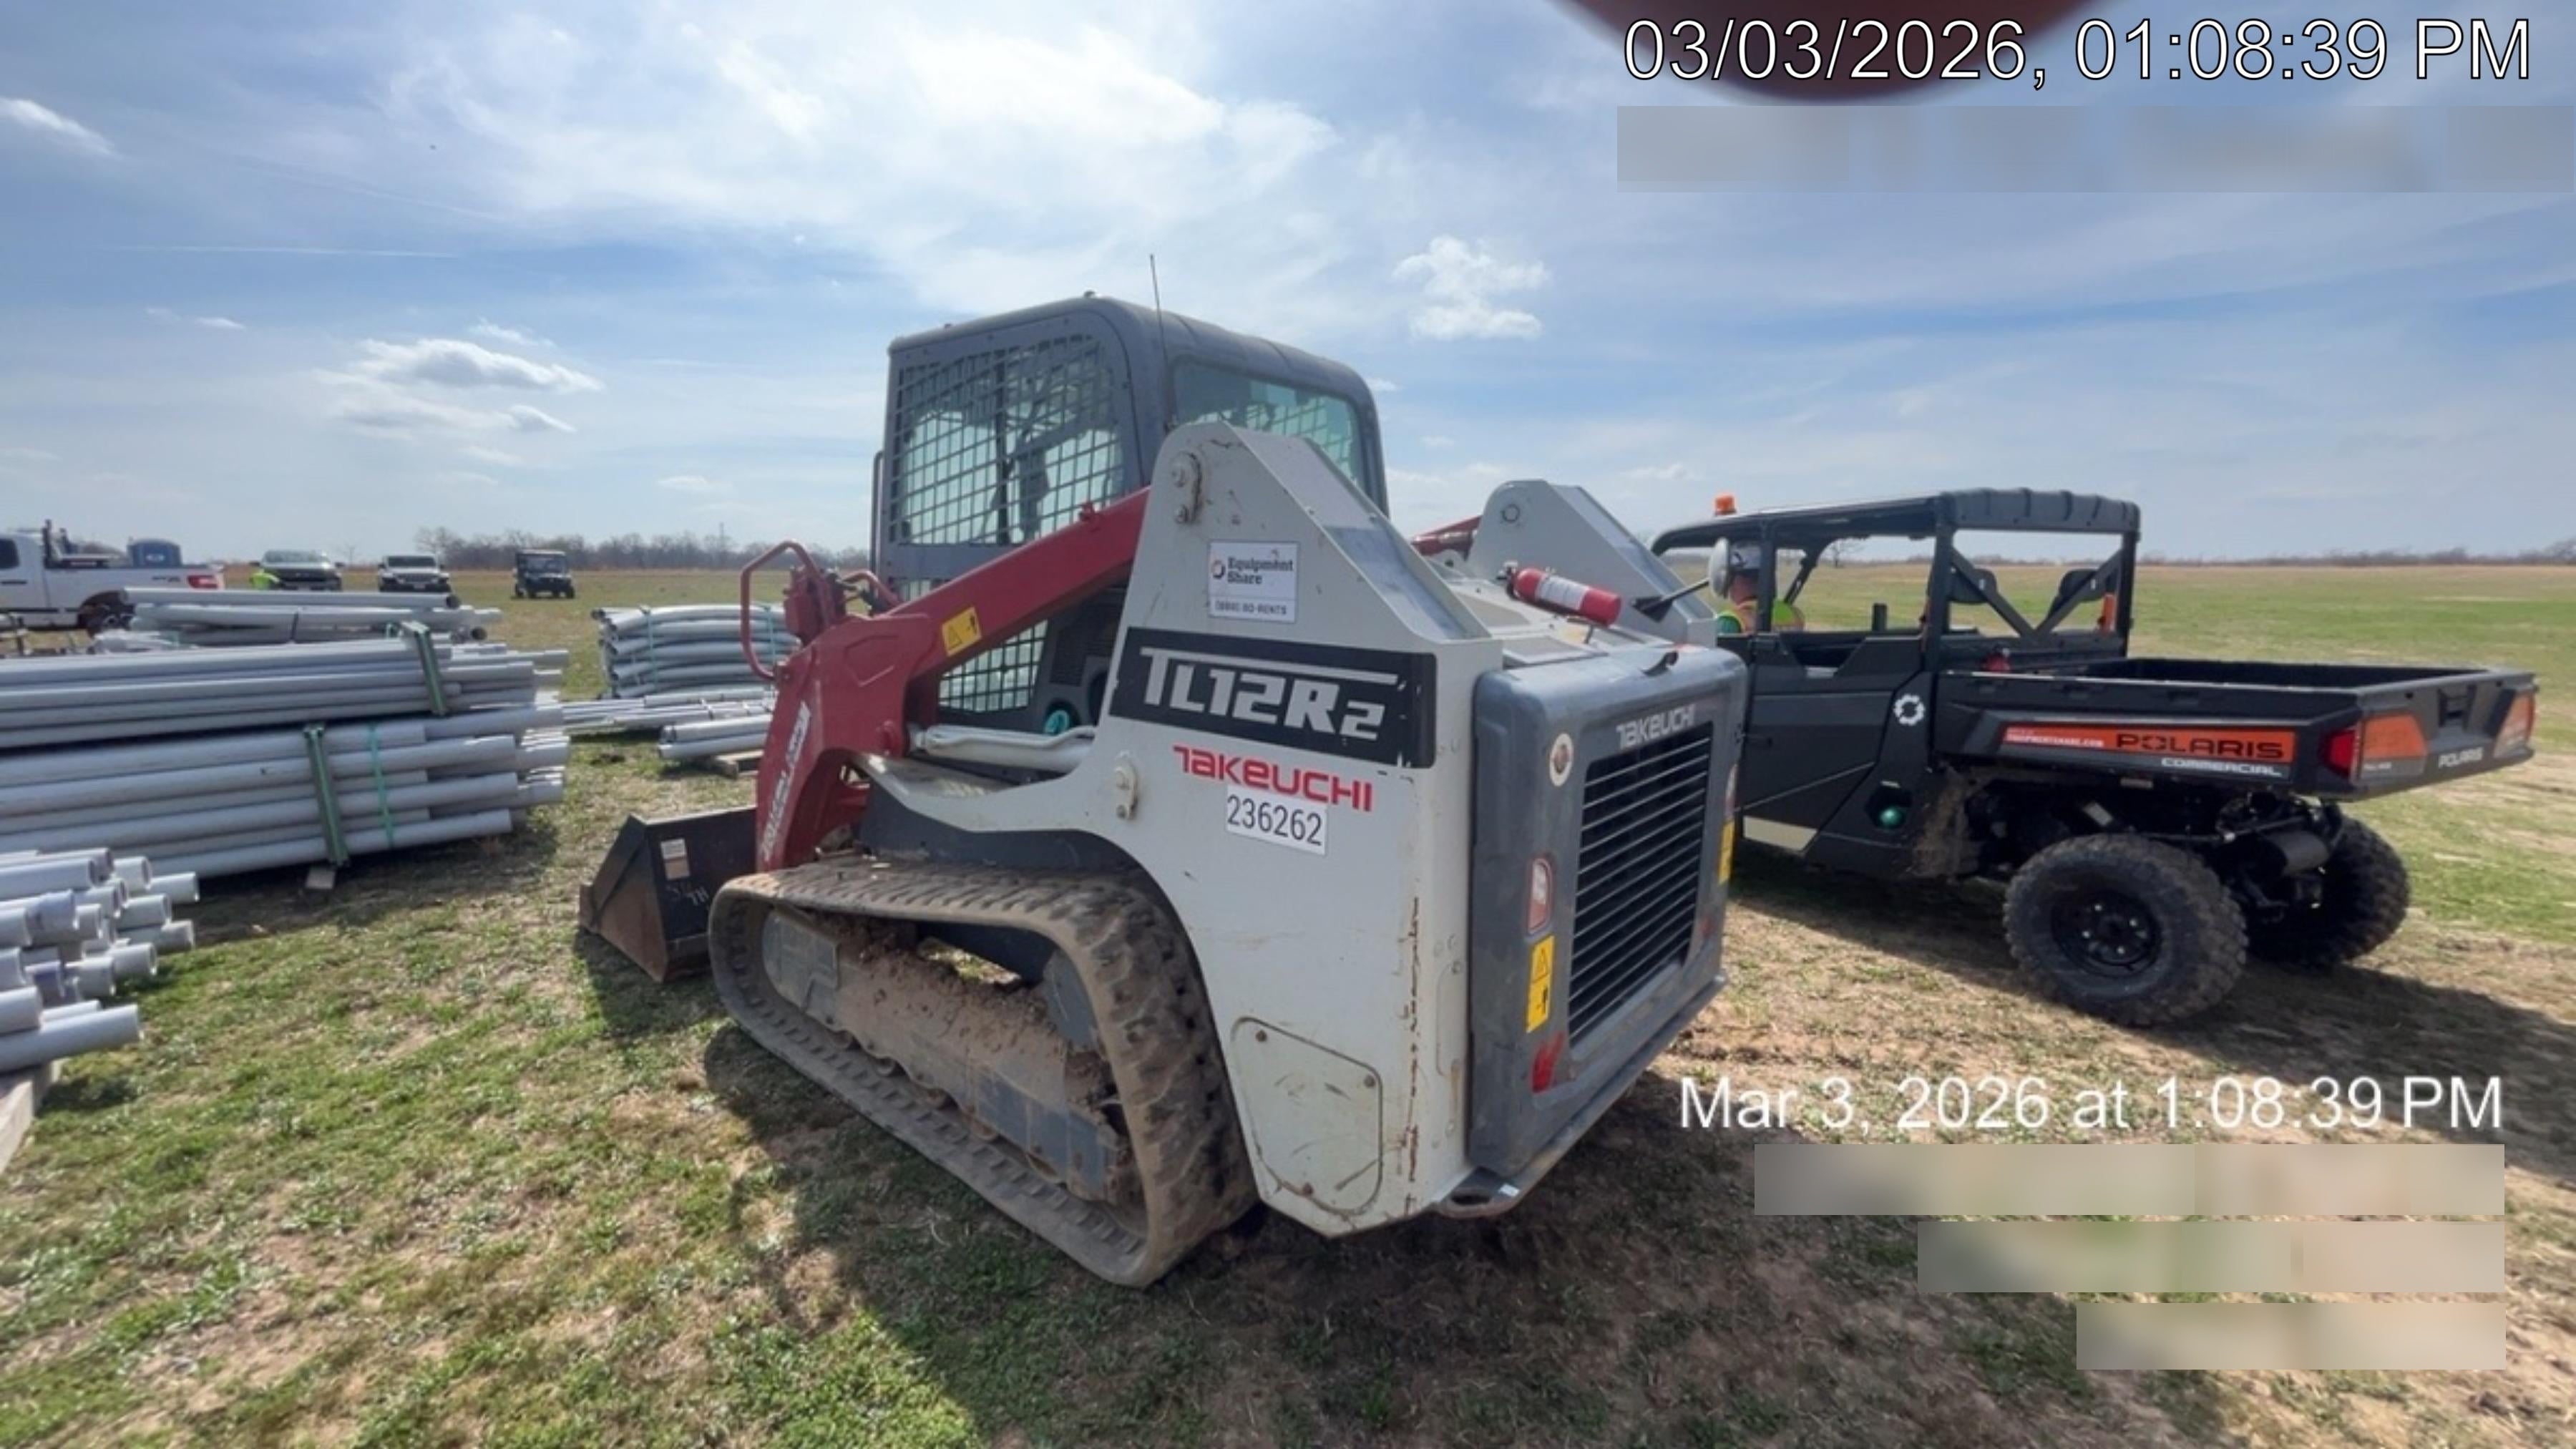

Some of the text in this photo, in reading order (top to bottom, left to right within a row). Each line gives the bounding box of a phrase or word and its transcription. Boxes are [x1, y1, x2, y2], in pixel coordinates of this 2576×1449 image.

[1227, 557, 1293, 572] Equipment
[1227, 571, 1262, 585] Share
[1616, 704, 1696, 751] TAKEUCHI
[2116, 733, 2284, 758] POLARIS
[2161, 756, 2283, 777] COMMERCIAL
[2438, 747, 2484, 768] POLARIS
[1173, 744, 1373, 813] TAKEUCHI
[1226, 794, 1323, 847] 236262
